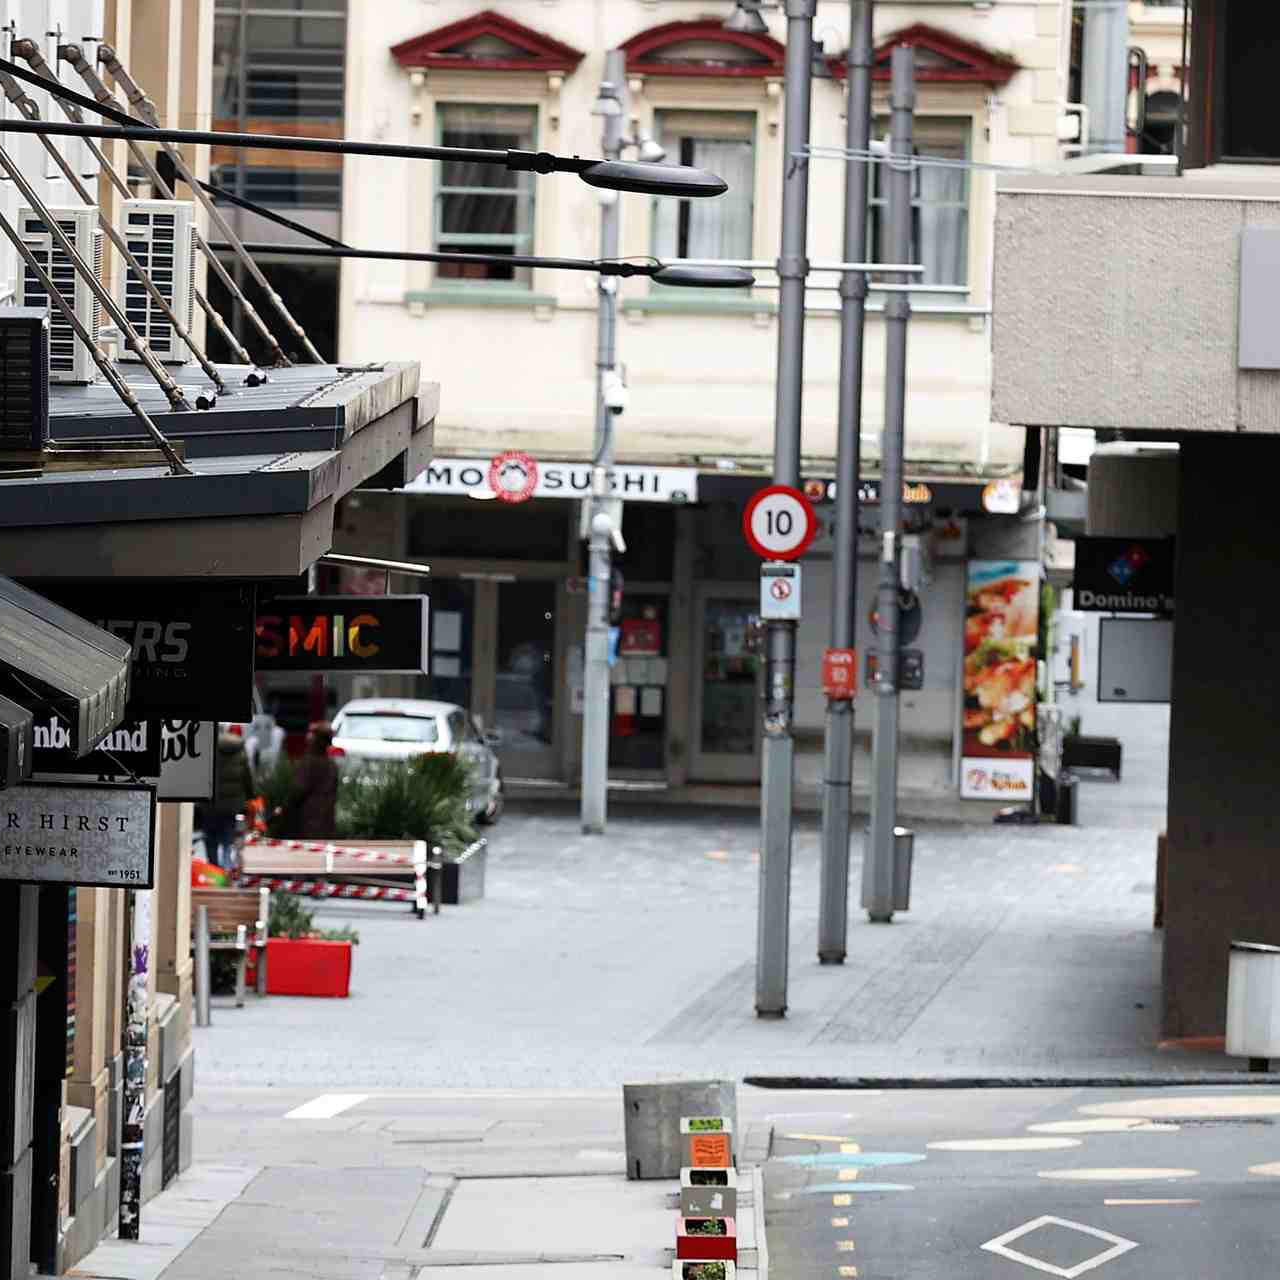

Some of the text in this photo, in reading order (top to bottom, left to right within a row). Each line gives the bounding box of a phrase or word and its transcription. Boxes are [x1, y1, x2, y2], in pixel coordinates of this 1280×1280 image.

[766, 510, 792, 536] 10
[40, 813, 129, 832] HIRST
[5, 846, 78, 858] EYEWEAR
[120, 870, 140, 879] 1951
